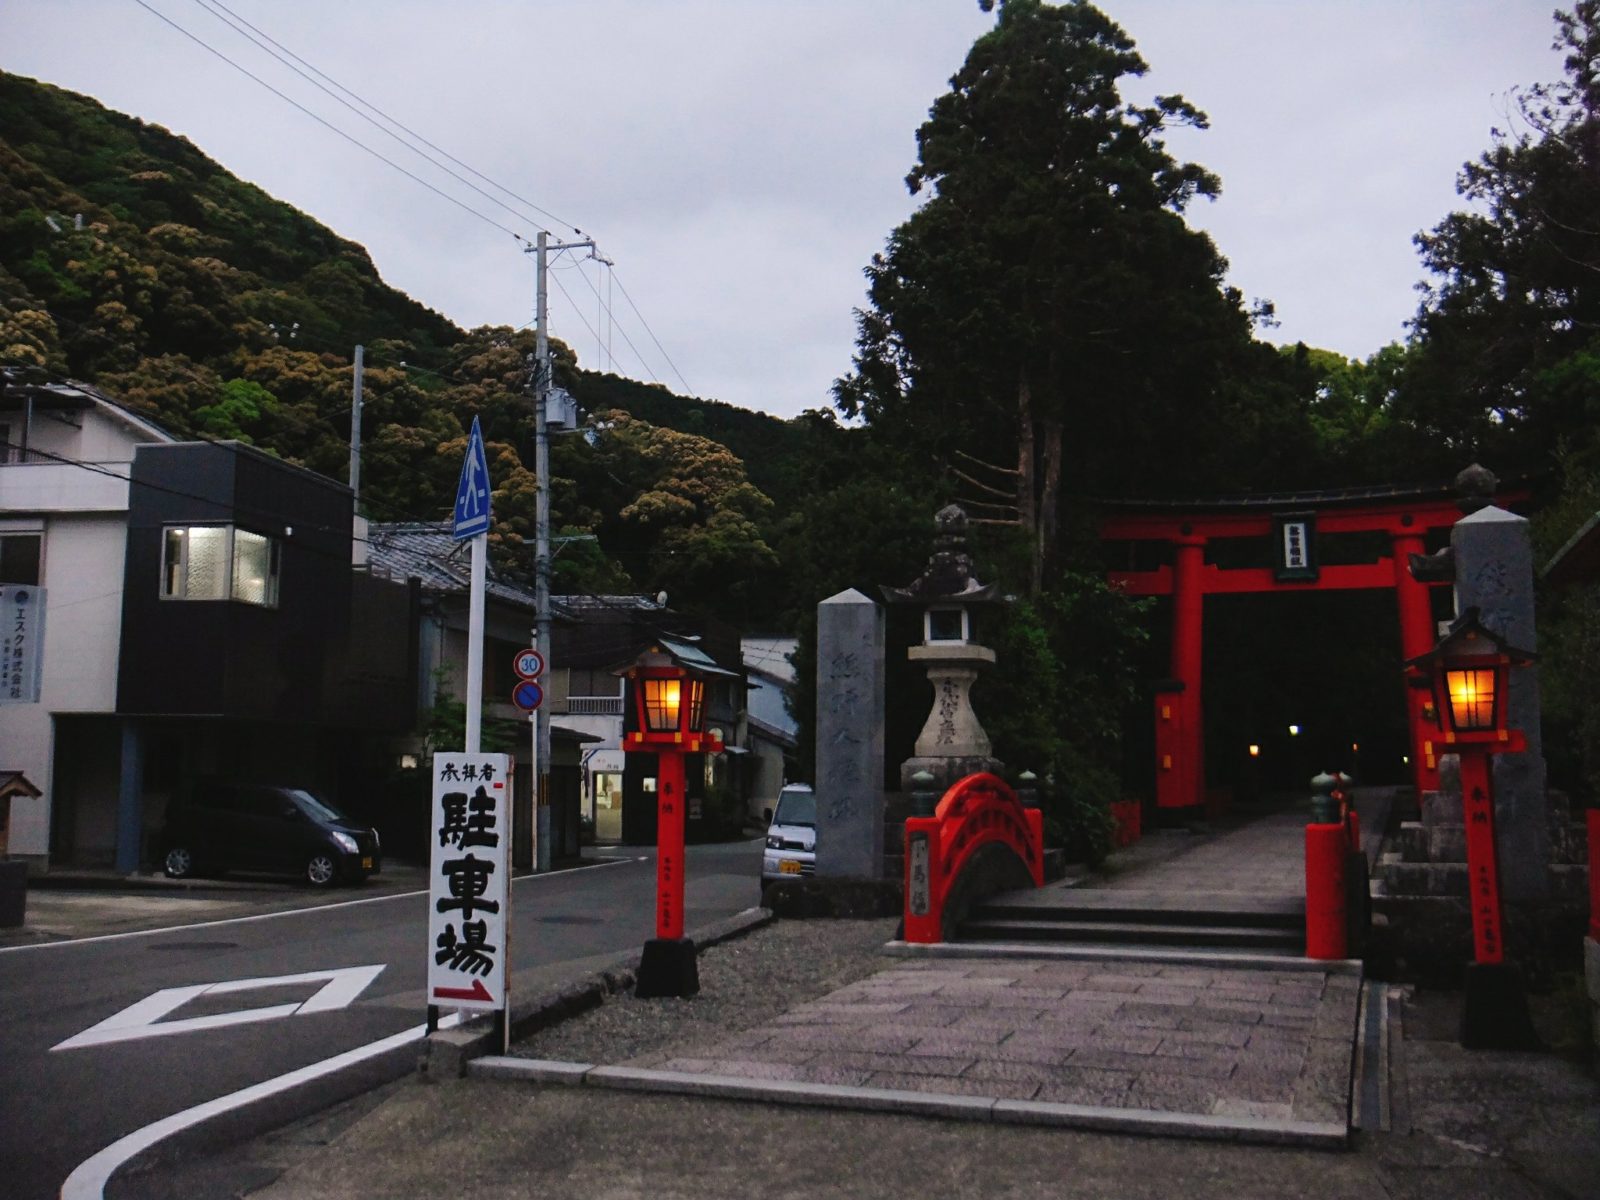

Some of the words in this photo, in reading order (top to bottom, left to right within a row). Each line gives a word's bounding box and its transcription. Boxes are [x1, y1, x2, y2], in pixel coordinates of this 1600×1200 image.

[10, 608, 26, 699] エスク株式会社
[521, 658, 538, 672] 30
[441, 762, 497, 782] 参拝者
[436, 785, 499, 977] 駐車場
